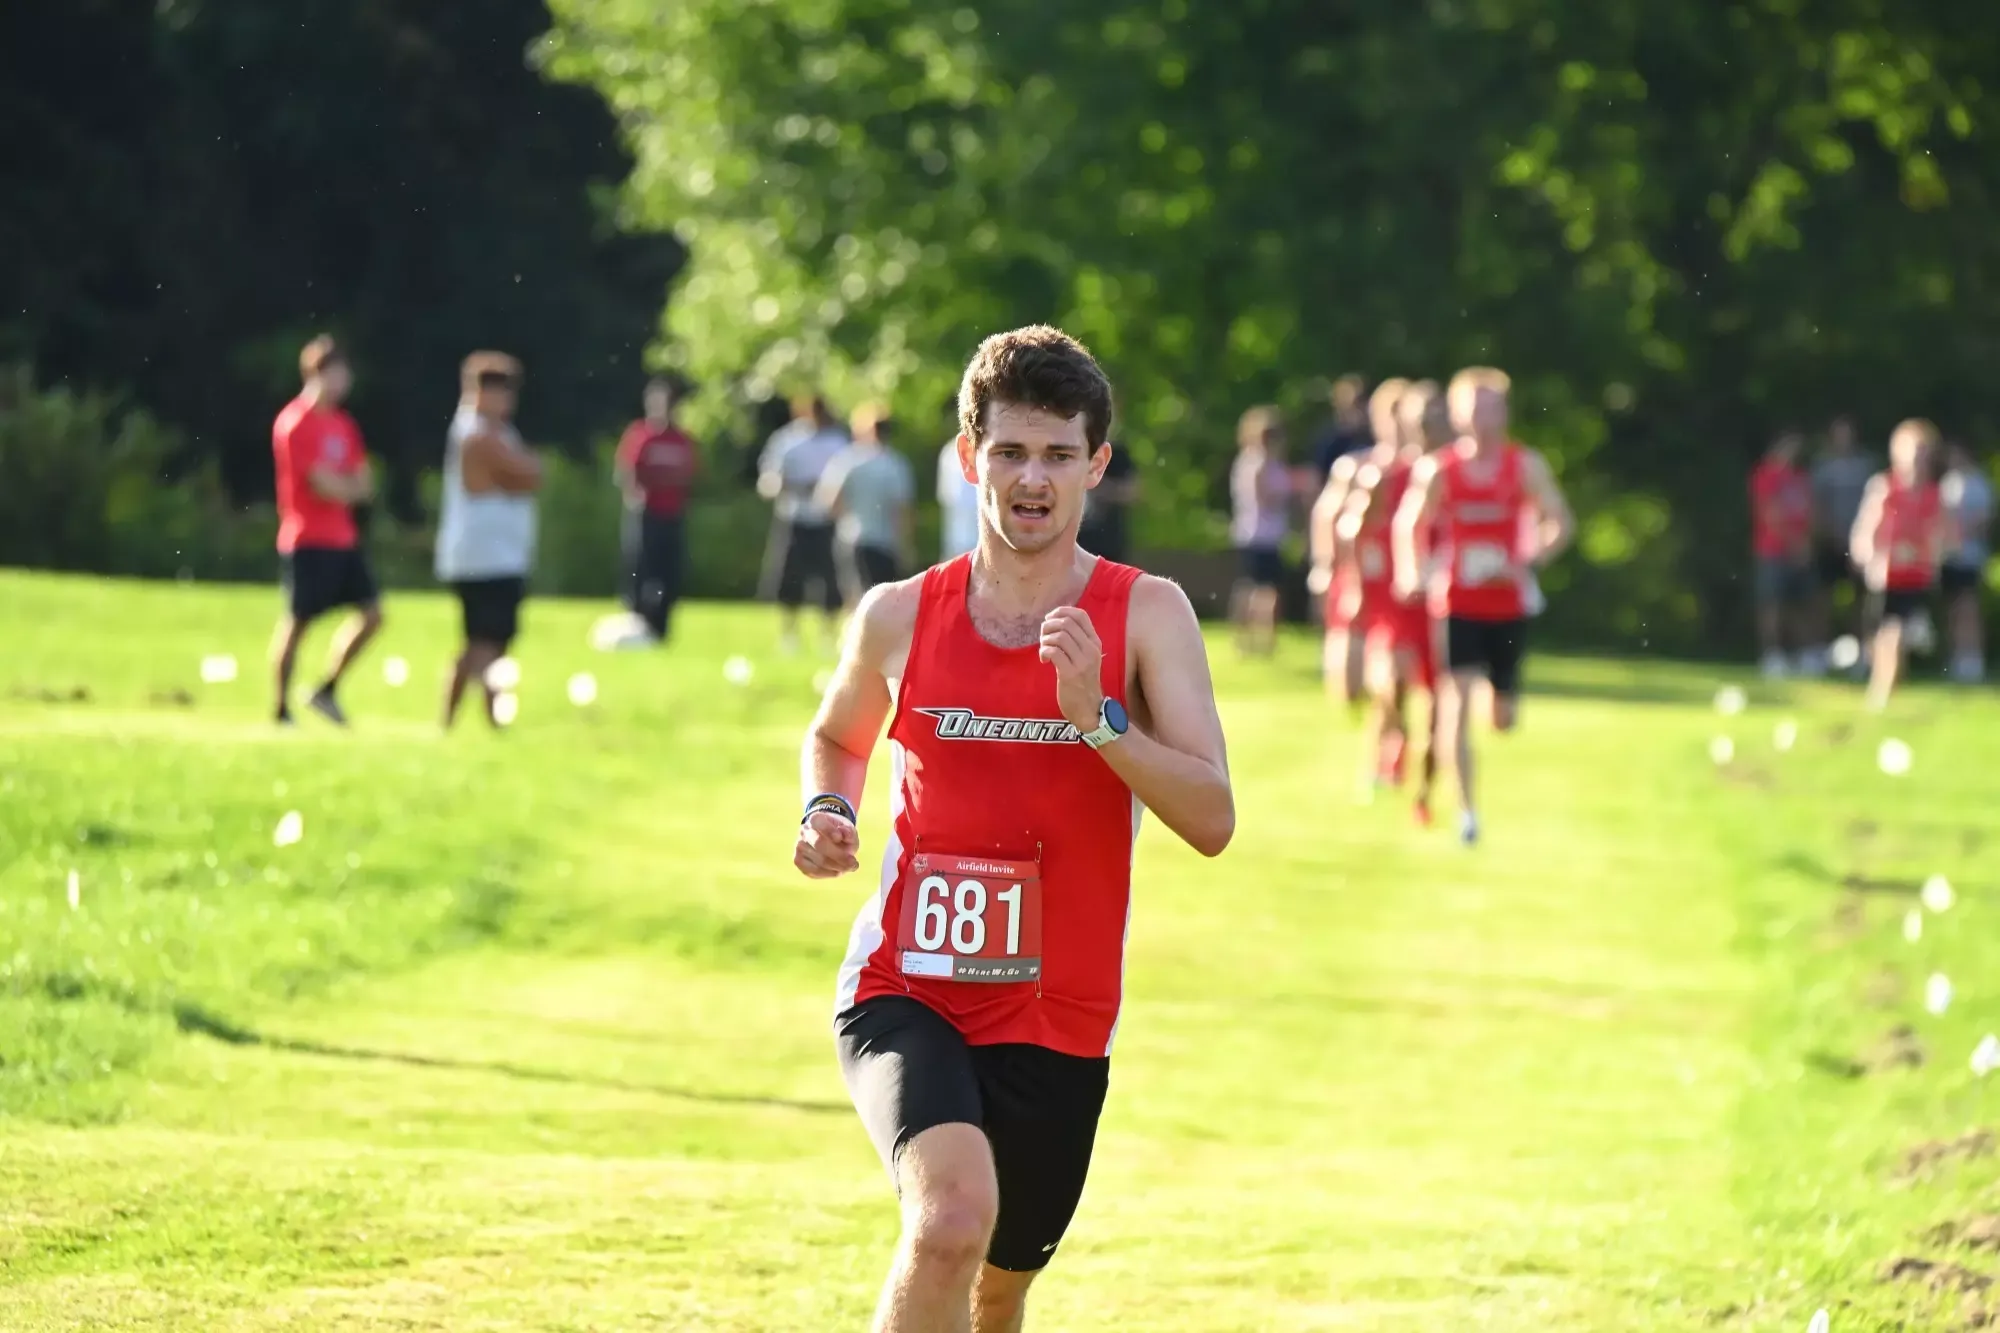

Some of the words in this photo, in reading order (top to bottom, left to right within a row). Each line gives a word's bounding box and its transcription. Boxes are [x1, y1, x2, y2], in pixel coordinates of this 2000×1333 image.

[922, 708, 1079, 743] ONEONTA
[956, 861, 988, 873] Airfield
[989, 863, 1015, 875] Invite
[914, 876, 1022, 955] 681
